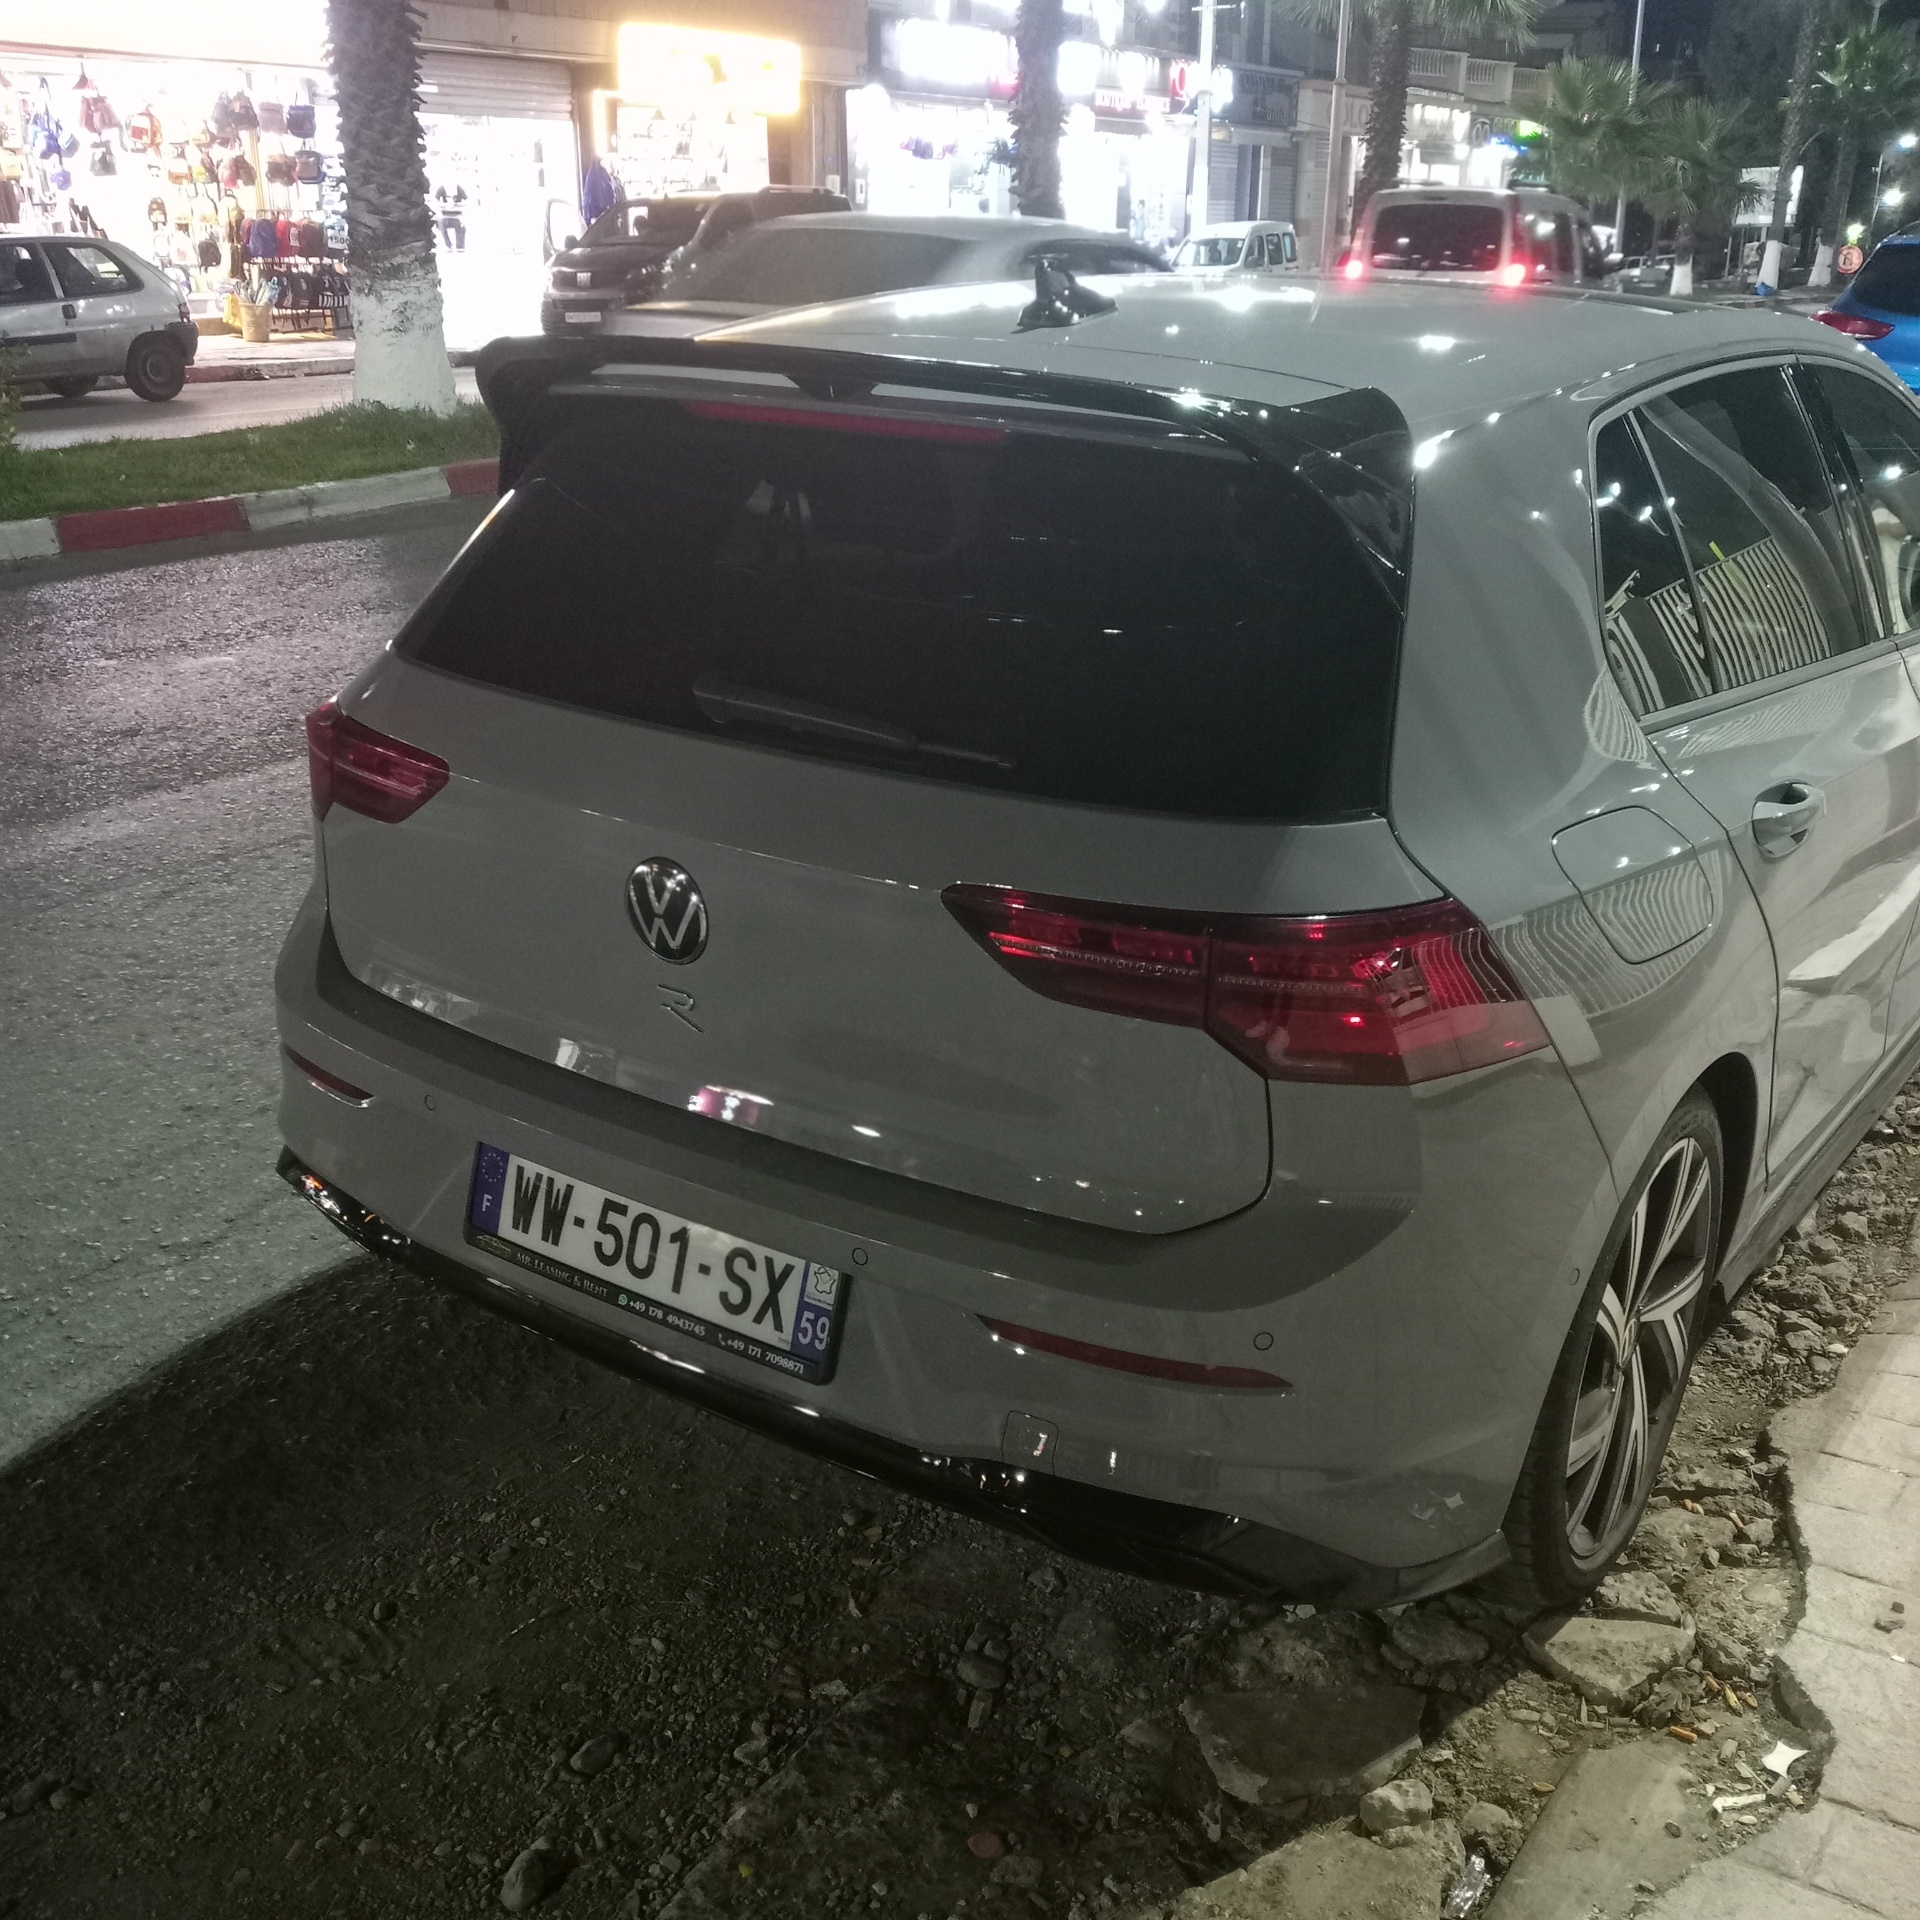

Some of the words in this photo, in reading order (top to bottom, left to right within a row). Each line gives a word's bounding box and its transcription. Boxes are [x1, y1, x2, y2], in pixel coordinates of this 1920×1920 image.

[481, 1193, 493, 1212] F
[511, 1164, 796, 1334] WW-501-SX
[573, 1275, 582, 1287] &
[583, 1278, 609, 1297] RENT
[628, 1301, 646, 1313] +49
[648, 1306, 664, 1319] 178
[666, 1314, 706, 1336] 4943745
[797, 1310, 831, 1351] 59
[727, 1339, 745, 1351] +49
[748, 1345, 762, 1358] 171
[765, 1352, 805, 1374] 7098871
